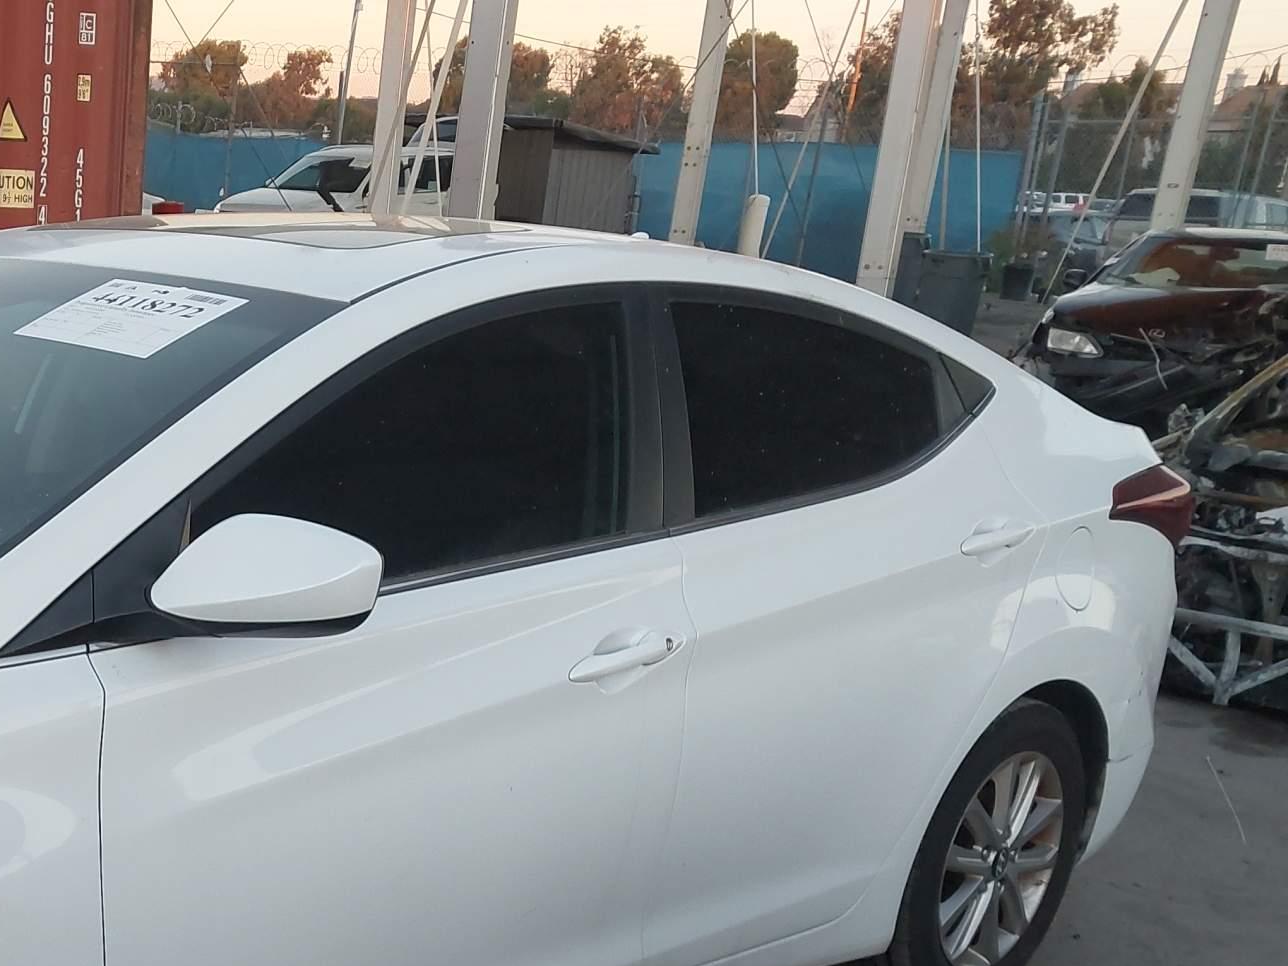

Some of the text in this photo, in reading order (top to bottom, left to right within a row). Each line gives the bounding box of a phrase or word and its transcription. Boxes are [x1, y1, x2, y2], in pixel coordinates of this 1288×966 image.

[37, 0, 54, 225] GHU 609322 4
[13, 194, 33, 203] HIGH
[75, 148, 84, 222] 45G1
[92, 291, 205, 319] 44118272
